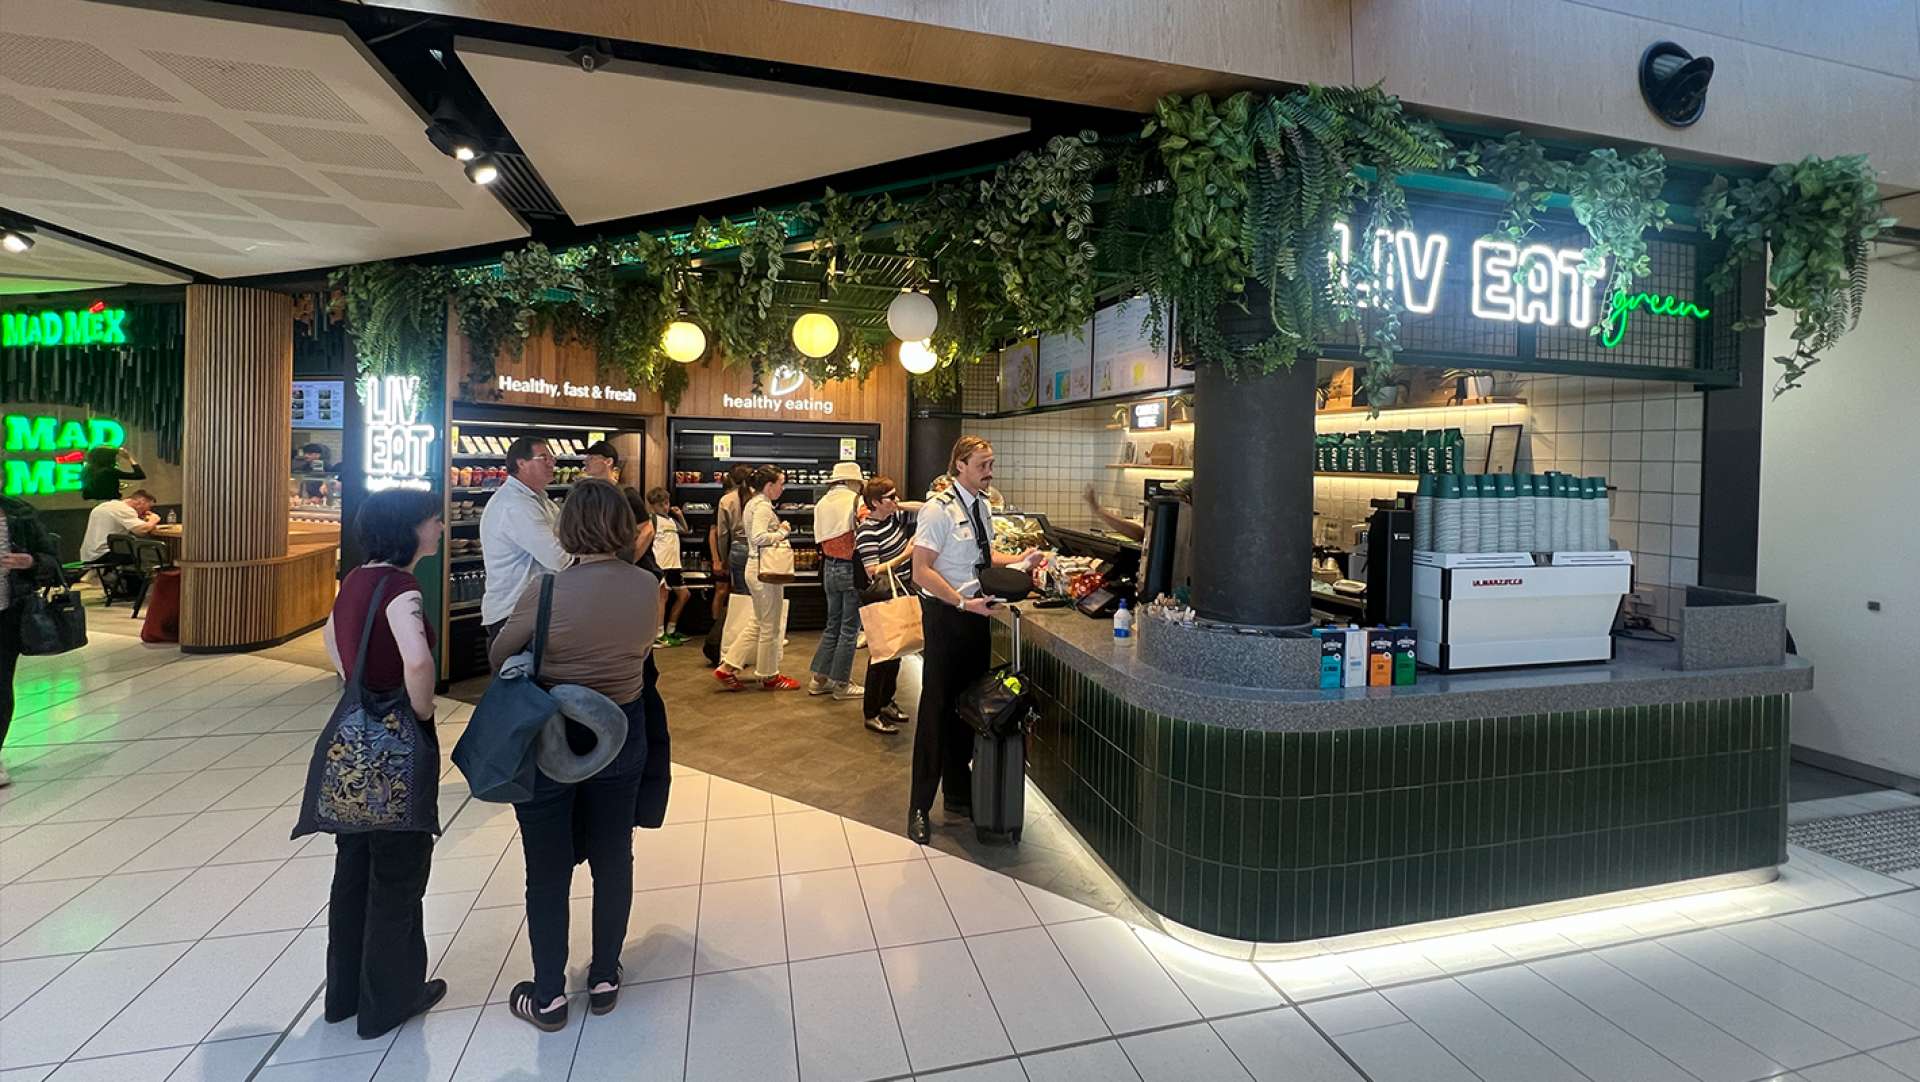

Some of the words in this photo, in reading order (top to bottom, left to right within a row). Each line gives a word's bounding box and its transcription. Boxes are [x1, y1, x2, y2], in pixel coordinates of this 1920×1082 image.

[1327, 221, 1448, 314] LIV
[1472, 240, 1606, 329] EAT
[2, 311, 63, 347] MAD
[64, 308, 126, 345] MEX
[1603, 290, 1710, 349] green
[366, 375, 421, 427] LIV
[498, 375, 561, 398] Healthy,
[563, 381, 590, 398] fast
[591, 385, 603, 400] &
[604, 386, 637, 403] fresh
[723, 393, 783, 412] healthy
[784, 397, 834, 415] eating
[4, 415, 125, 452] MAD
[366, 424, 435, 477] EAT
[4, 459, 83, 496] ME
